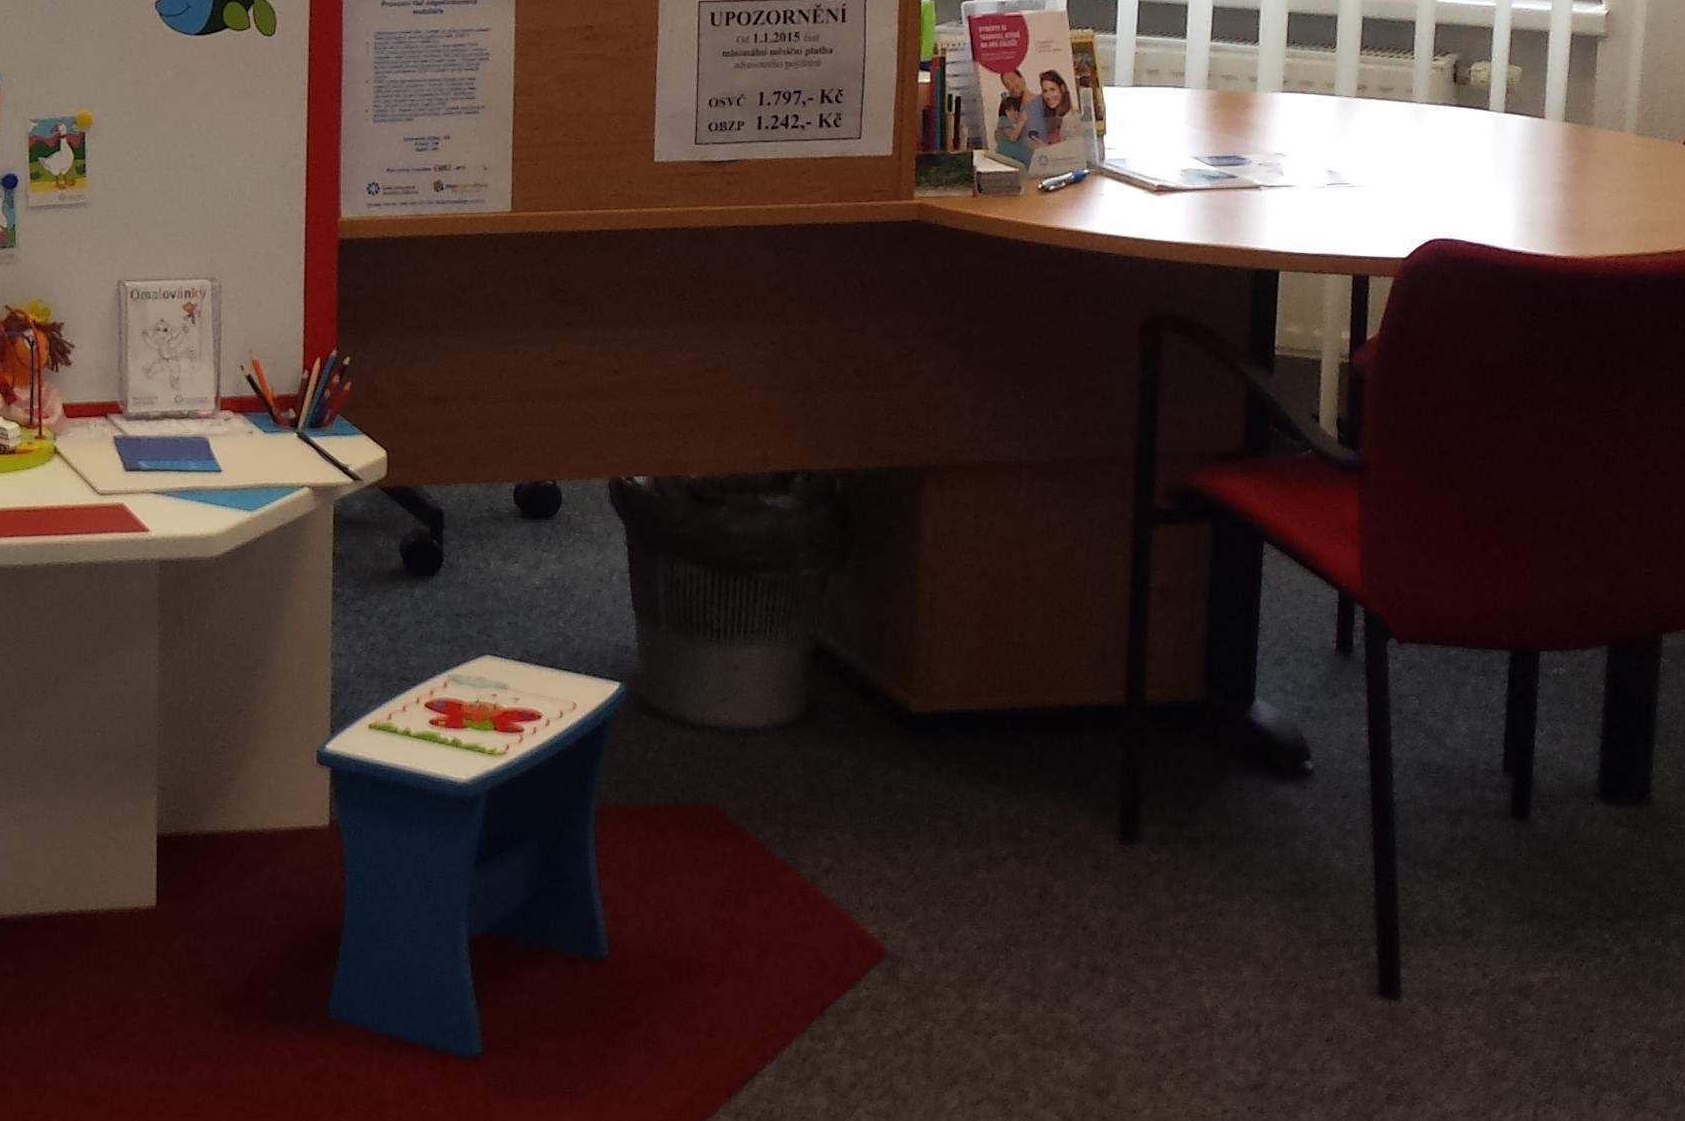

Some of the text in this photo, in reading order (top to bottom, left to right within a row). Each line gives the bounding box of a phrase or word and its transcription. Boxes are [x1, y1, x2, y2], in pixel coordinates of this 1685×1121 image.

[709, 3, 847, 27] UPOZORNĚNÍ
[736, 35, 750, 44] Od
[753, 32, 800, 44] 1.1.2015
[805, 46, 834, 57] platba
[708, 88, 844, 108] OSVČ 1.797,- Kč
[708, 112, 842, 132] OBZP 1.242,- Kč
[130, 287, 207, 301] Omalovánky
